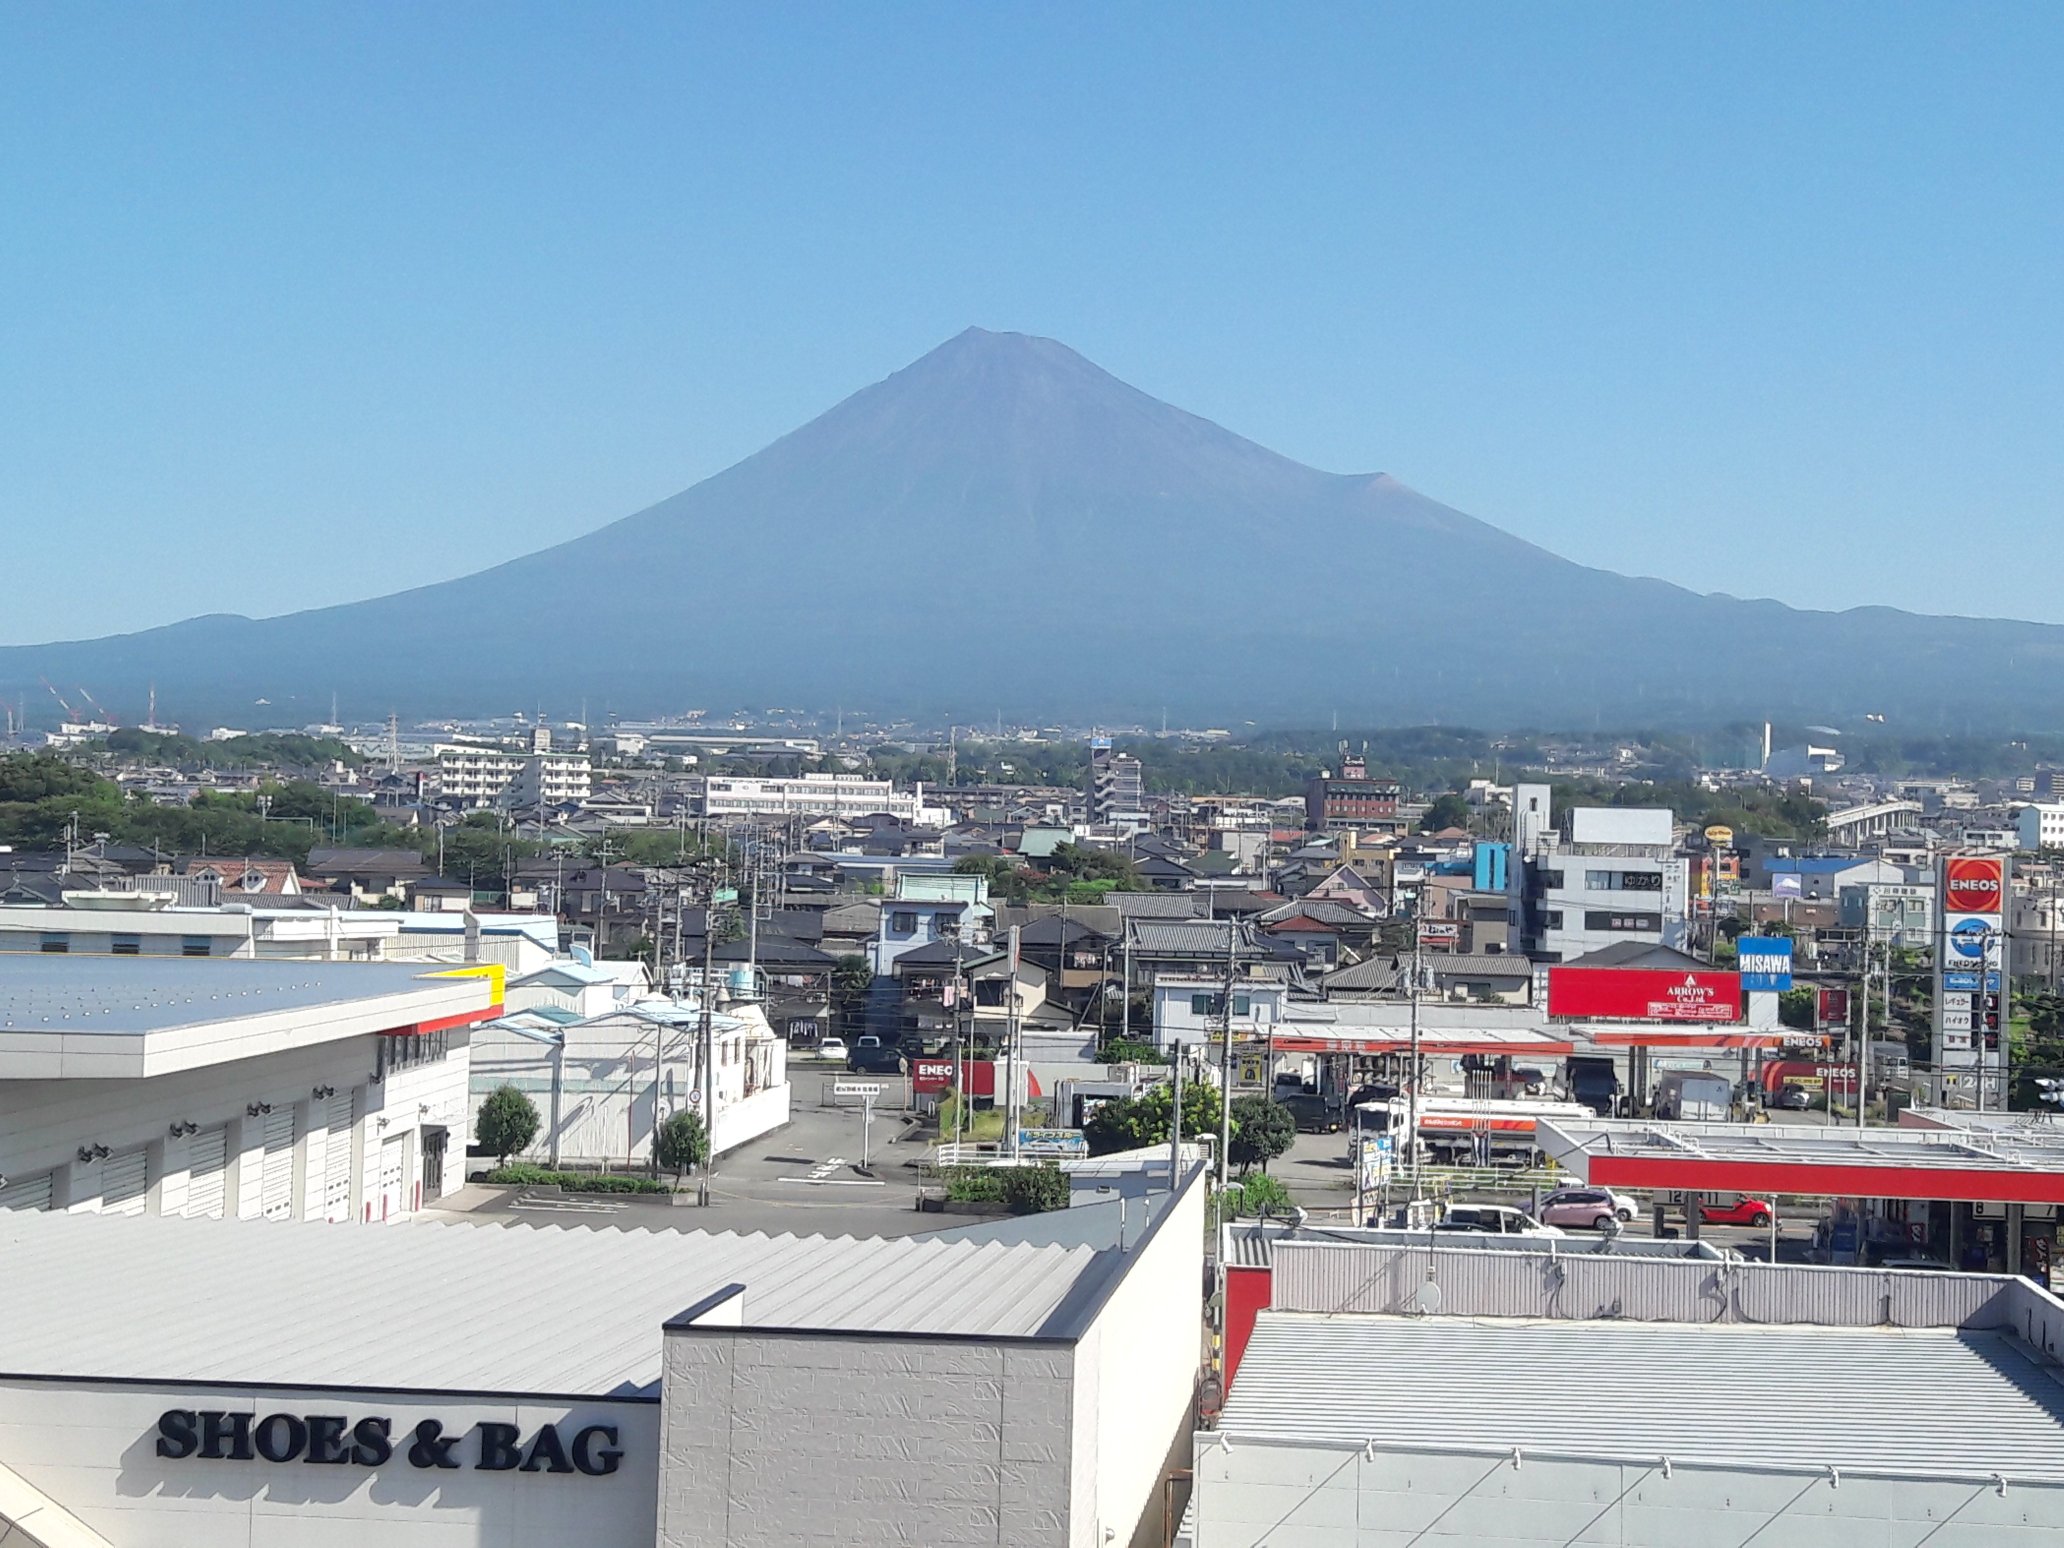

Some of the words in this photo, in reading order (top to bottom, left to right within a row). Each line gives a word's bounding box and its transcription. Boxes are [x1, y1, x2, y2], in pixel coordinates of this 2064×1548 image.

[1950, 879, 1998, 891] ENEOS
[1740, 954, 1790, 973] MISAWA
[1667, 987, 1714, 997] ARROW'S
[1783, 1036, 1823, 1047] ENEOS
[919, 1065, 953, 1076] ENEO
[1816, 1067, 1856, 1078] ENEOS
[1668, 1190, 1682, 1203] 12
[1707, 1192, 1718, 1205] 11
[1975, 1202, 1984, 1214] 8
[156, 1409, 393, 1467] SHOES
[408, 1418, 462, 1470] &
[474, 1421, 625, 1476] BAG
